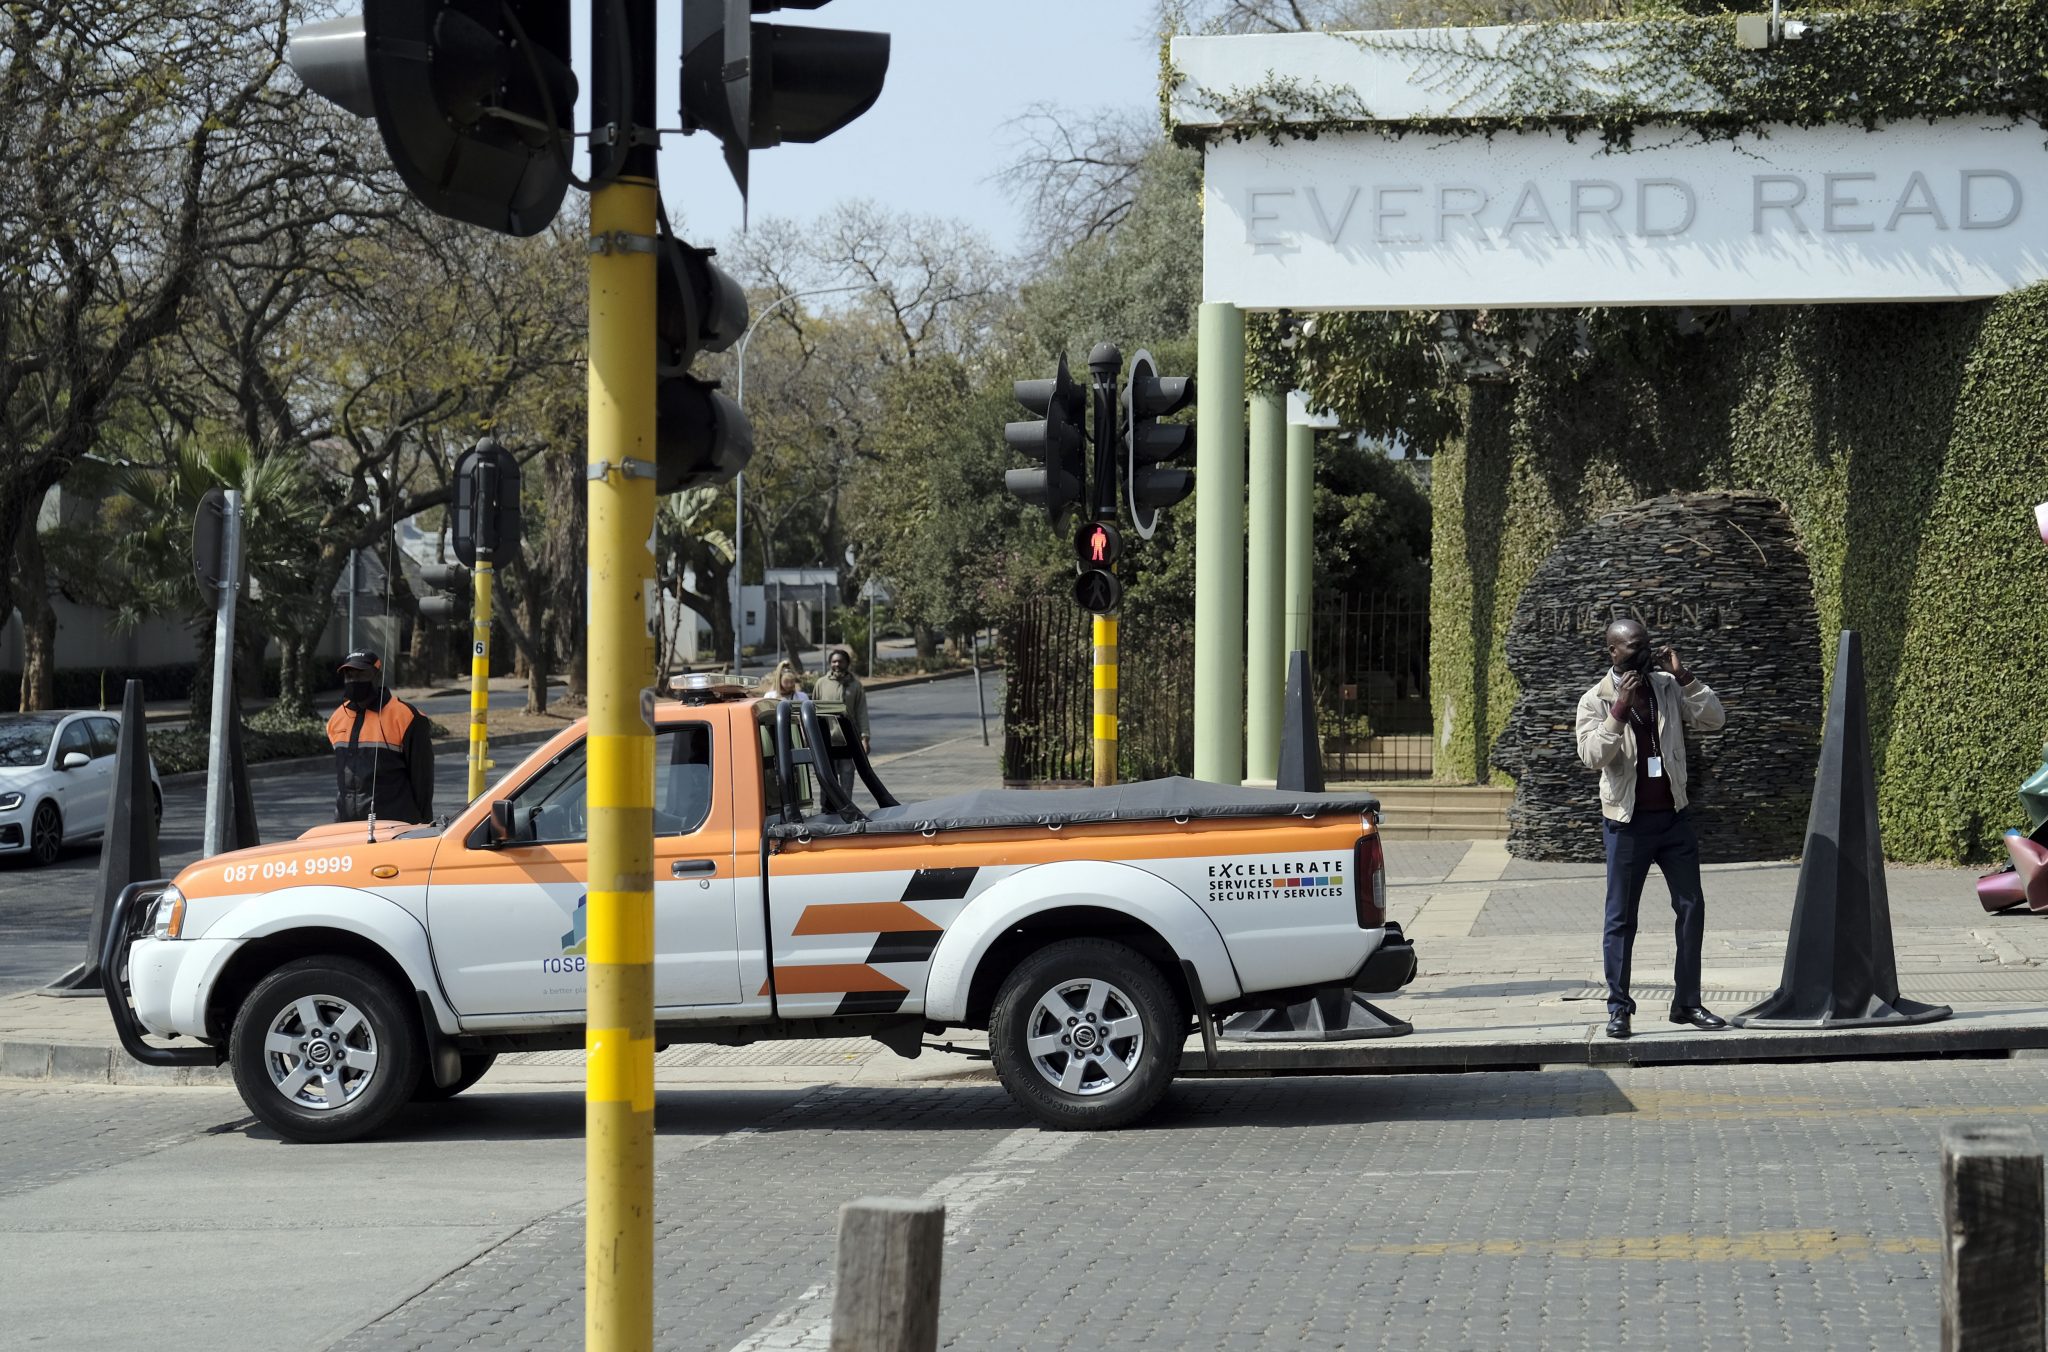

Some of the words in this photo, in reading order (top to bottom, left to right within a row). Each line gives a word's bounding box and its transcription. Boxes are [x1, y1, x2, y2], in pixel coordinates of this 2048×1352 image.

[1243, 177, 1697, 250] EVERARD
[1752, 168, 2024, 236] READ
[475, 642, 483, 654] 6
[223, 864, 259, 883] 087
[262, 859, 298, 879] 094
[304, 855, 353, 875] 9999
[1208, 861, 1342, 878] EXCELLERATE
[1209, 879, 1272, 890] SERVICES
[1209, 890, 1279, 901] SECURITY
[1284, 887, 1343, 898] SERVICES
